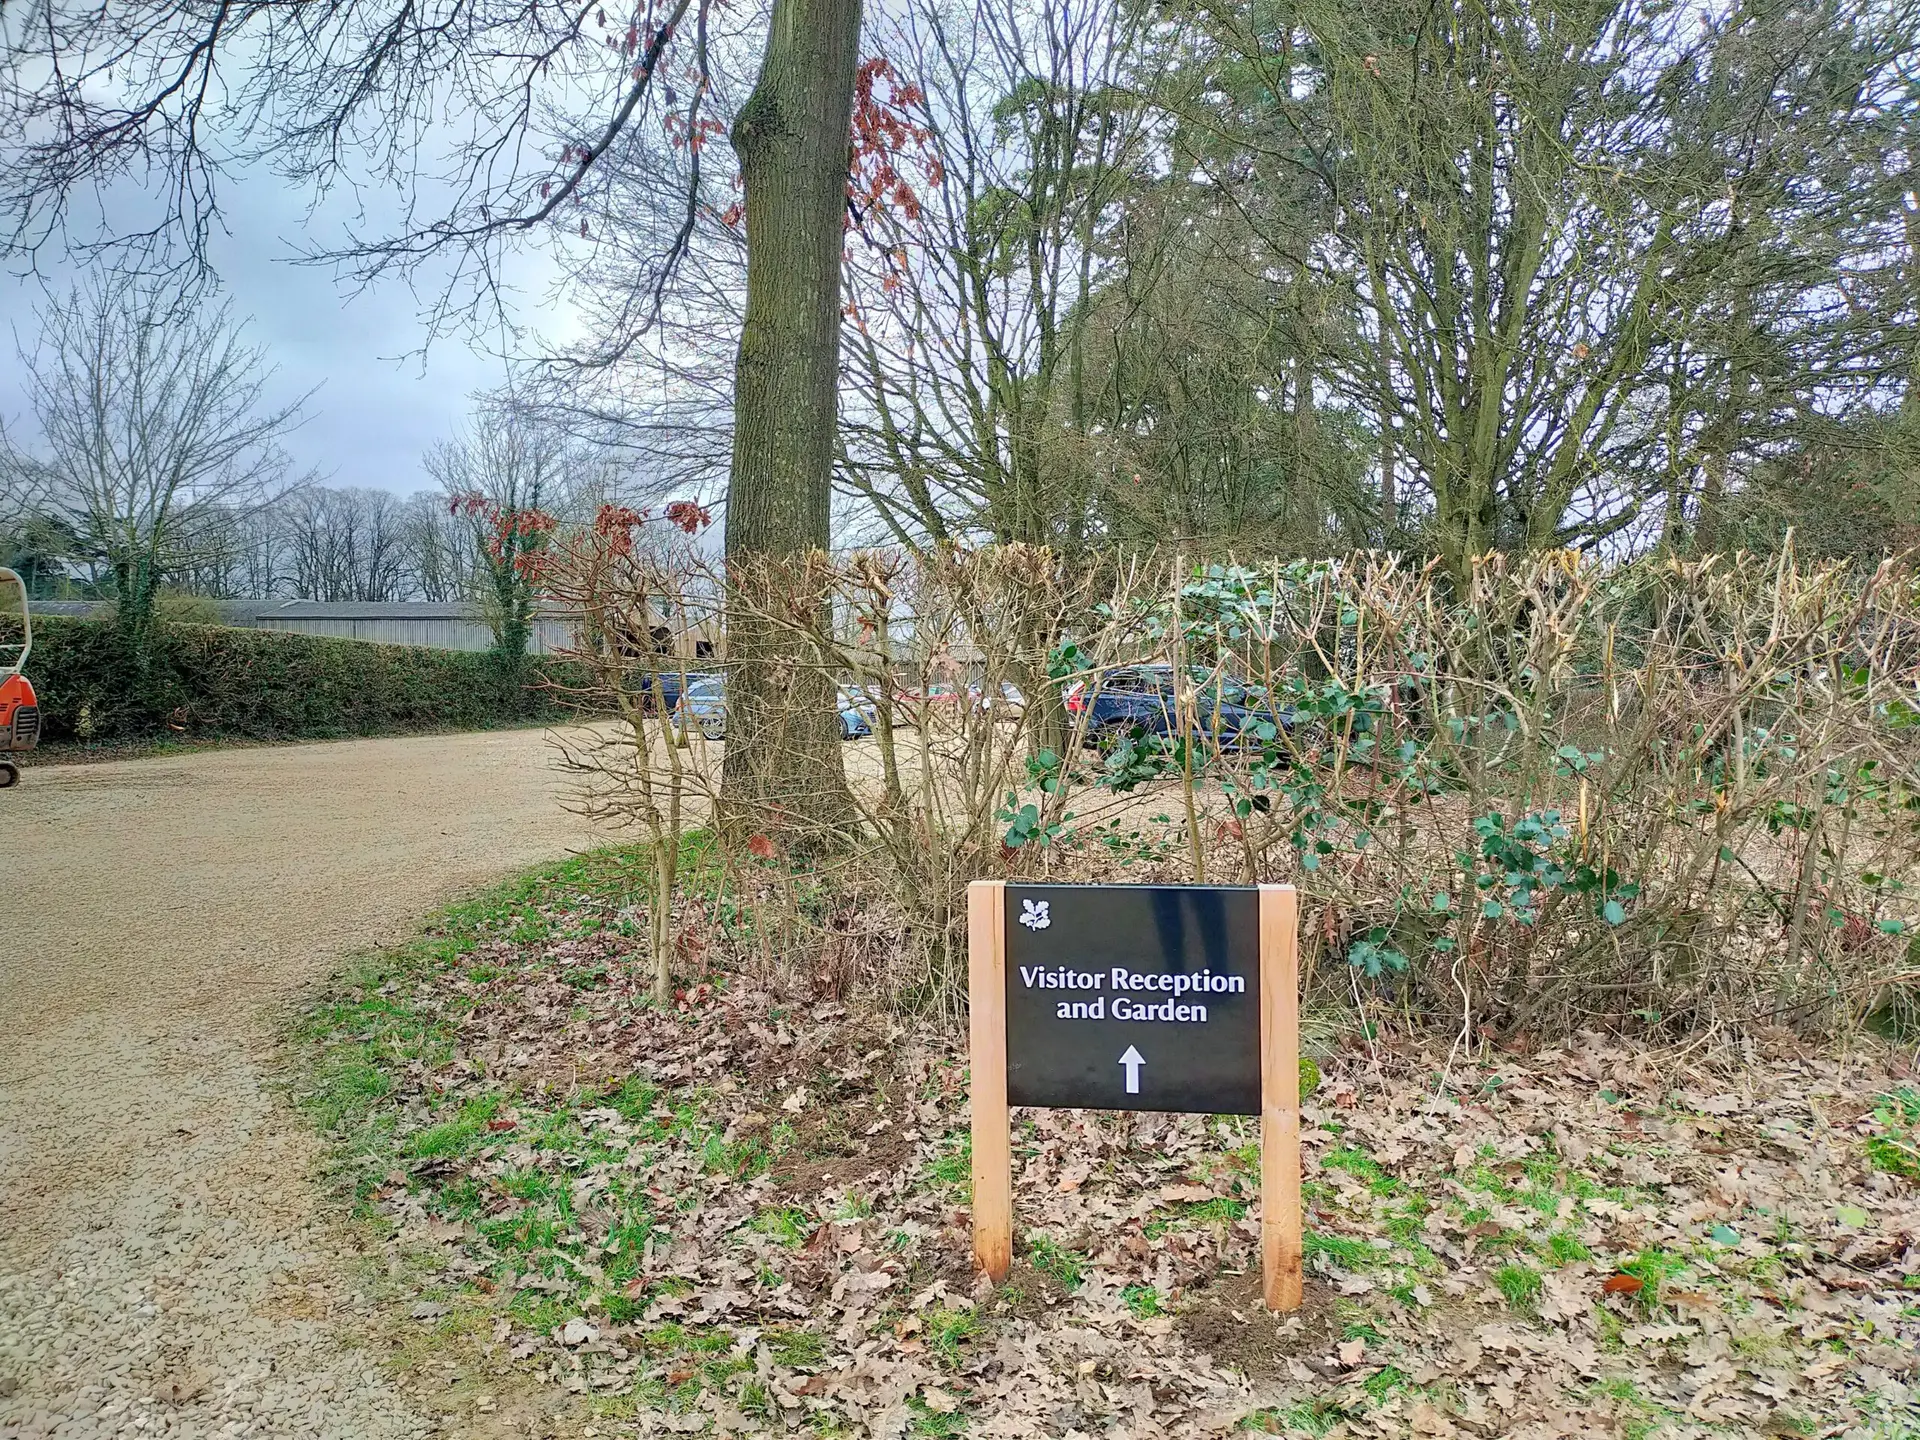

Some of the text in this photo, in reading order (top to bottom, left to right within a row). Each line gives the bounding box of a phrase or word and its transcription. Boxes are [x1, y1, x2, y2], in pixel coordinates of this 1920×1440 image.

[1019, 965, 1245, 997] Visitor Reception
[1056, 996, 1207, 1022] and Garden
